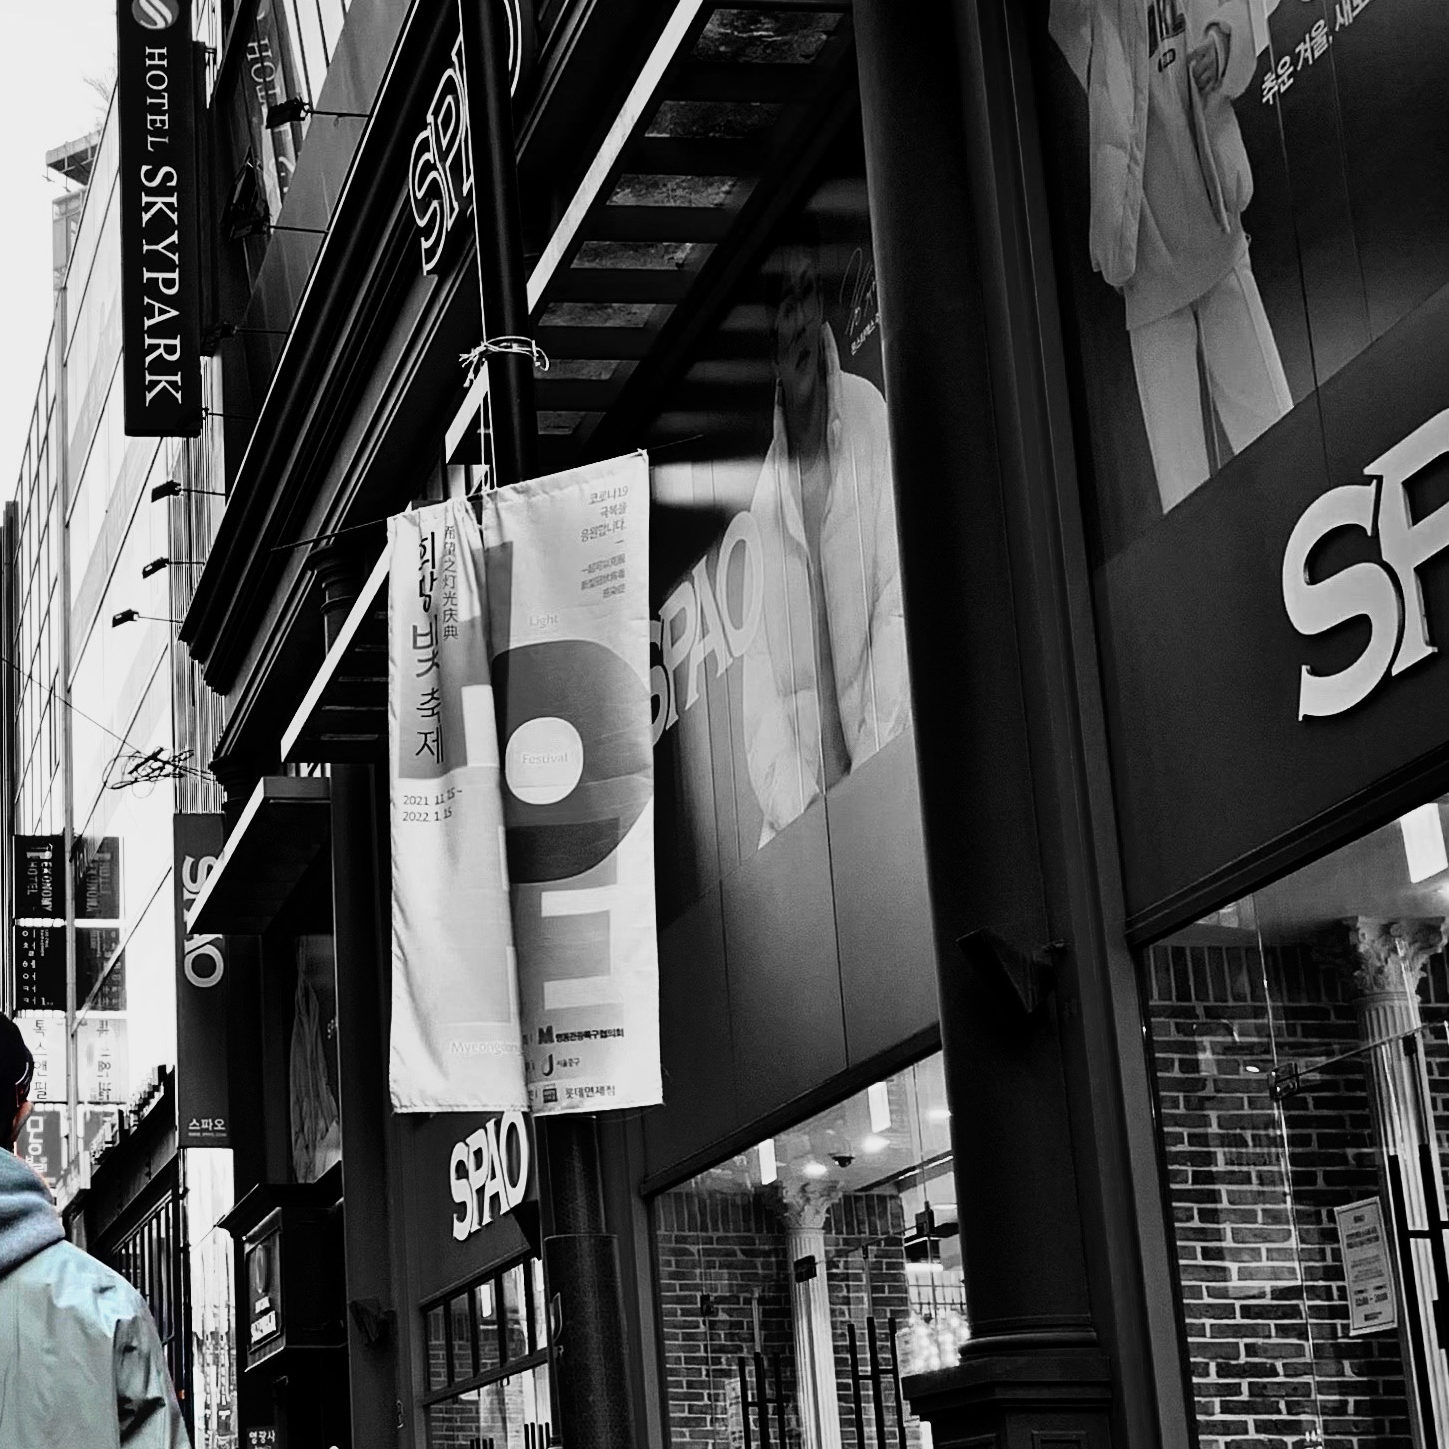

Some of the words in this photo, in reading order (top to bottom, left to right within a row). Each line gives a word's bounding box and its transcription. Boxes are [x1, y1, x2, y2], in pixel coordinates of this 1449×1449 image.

[145, 46, 169, 152] HOTEL
[1262, 56, 1294, 104] 추운
[140, 164, 182, 407] SKYPARK
[522, 751, 569, 765] Festival
[188, 1118, 226, 1131] 스파오
[450, 1110, 529, 1242] SPAO
